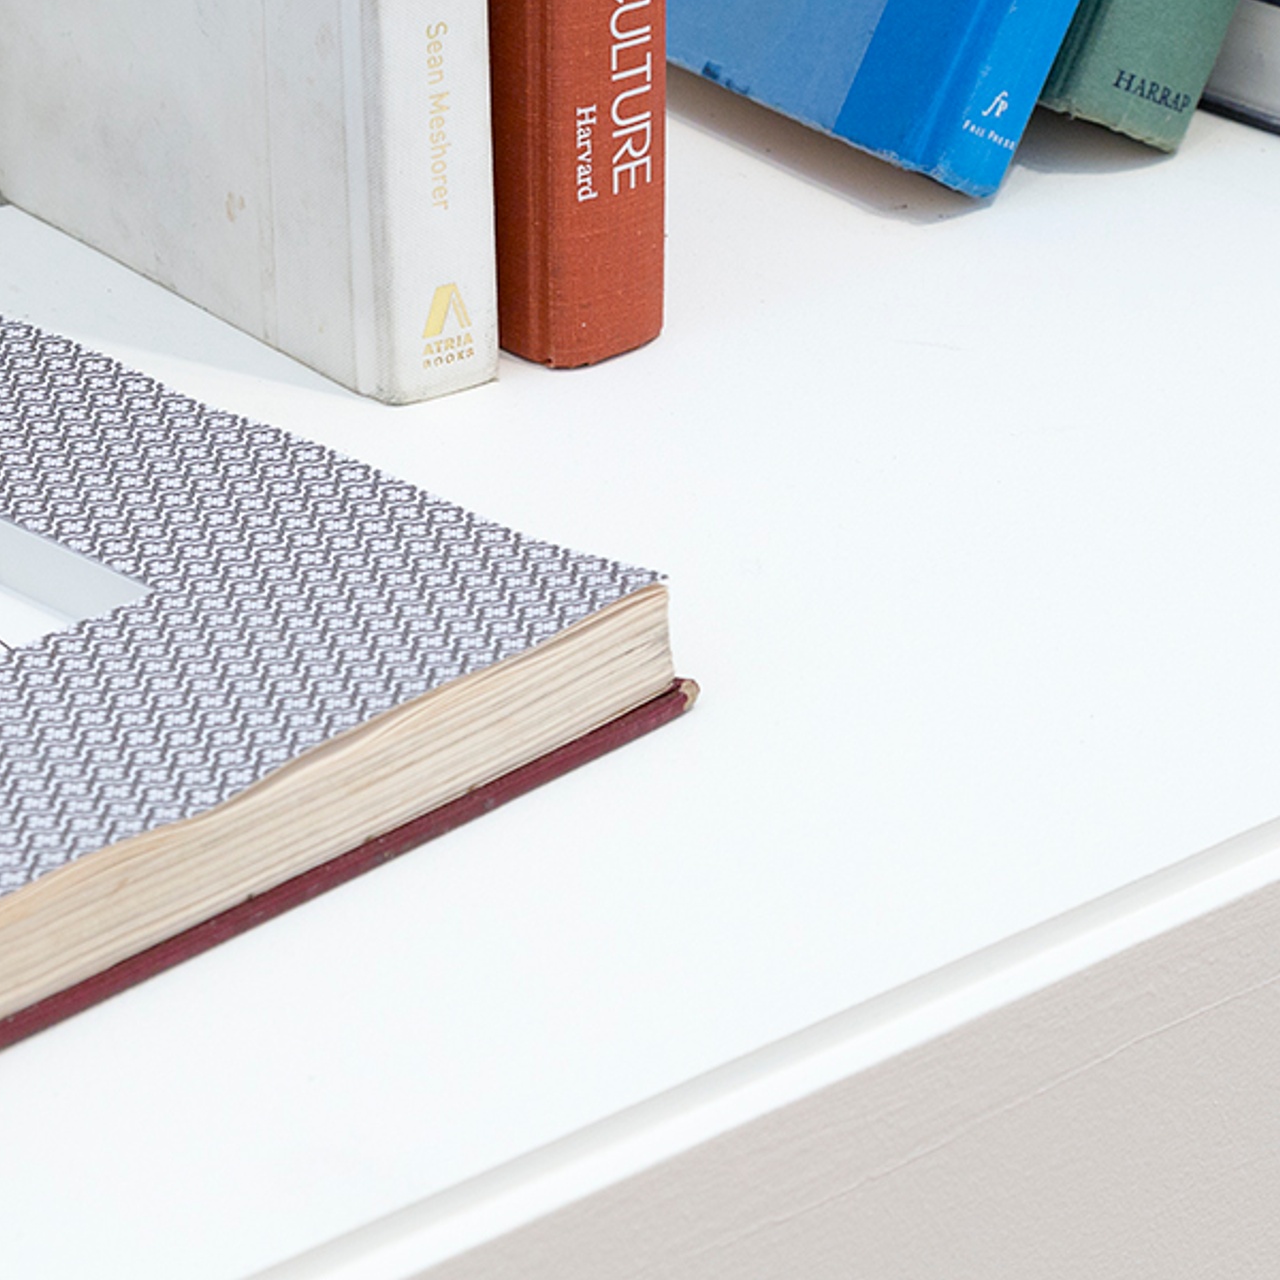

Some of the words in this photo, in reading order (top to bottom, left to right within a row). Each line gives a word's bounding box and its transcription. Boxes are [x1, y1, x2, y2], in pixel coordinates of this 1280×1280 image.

[425, 21, 450, 85] Sean
[1112, 68, 1192, 114] HARRAP
[429, 91, 452, 211] Meshorer
[576, 103, 598, 203] Harvard
[422, 332, 474, 357] ATRIA
[422, 347, 475, 370] BOOKS
